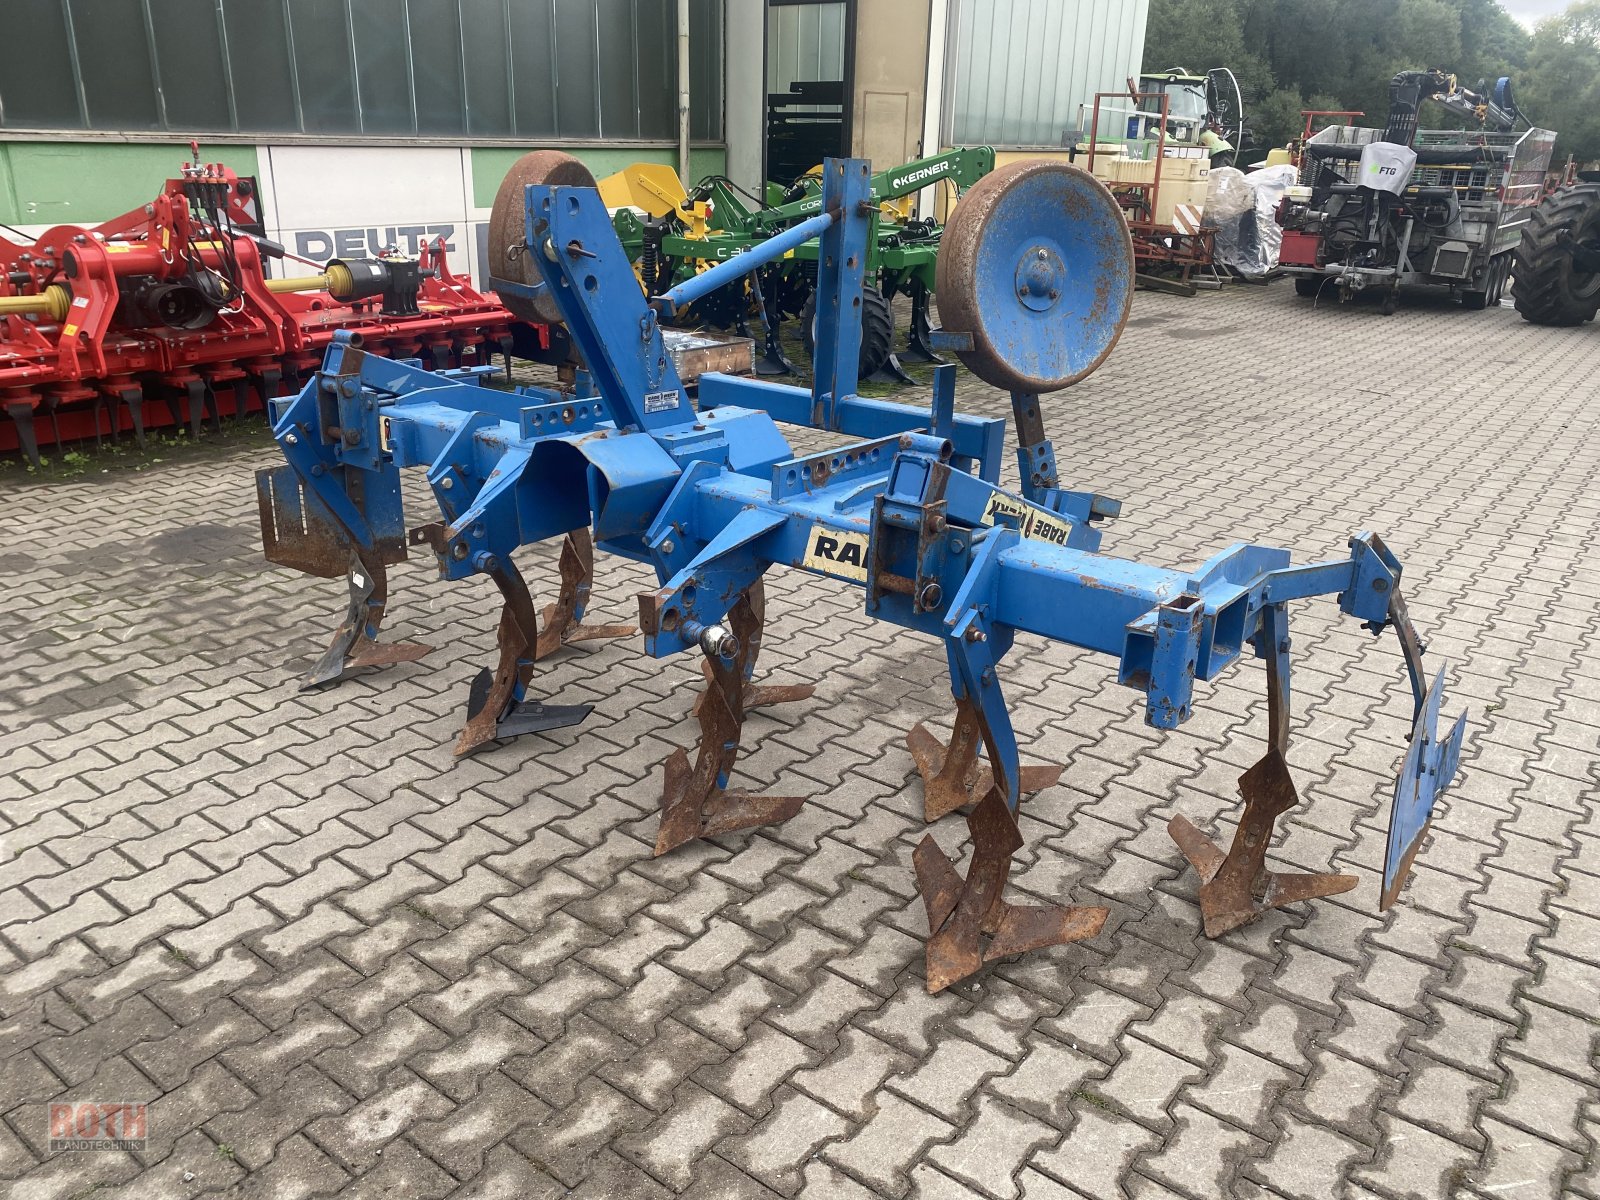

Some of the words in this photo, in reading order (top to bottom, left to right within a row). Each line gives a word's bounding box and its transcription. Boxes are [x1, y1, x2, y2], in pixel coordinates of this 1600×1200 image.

[900, 160, 949, 186] KERNER
[1379, 166, 1397, 176] FTG
[800, 200, 823, 211] COR
[294, 224, 456, 262] DEUTZ
[1033, 519, 1067, 546] RABE
